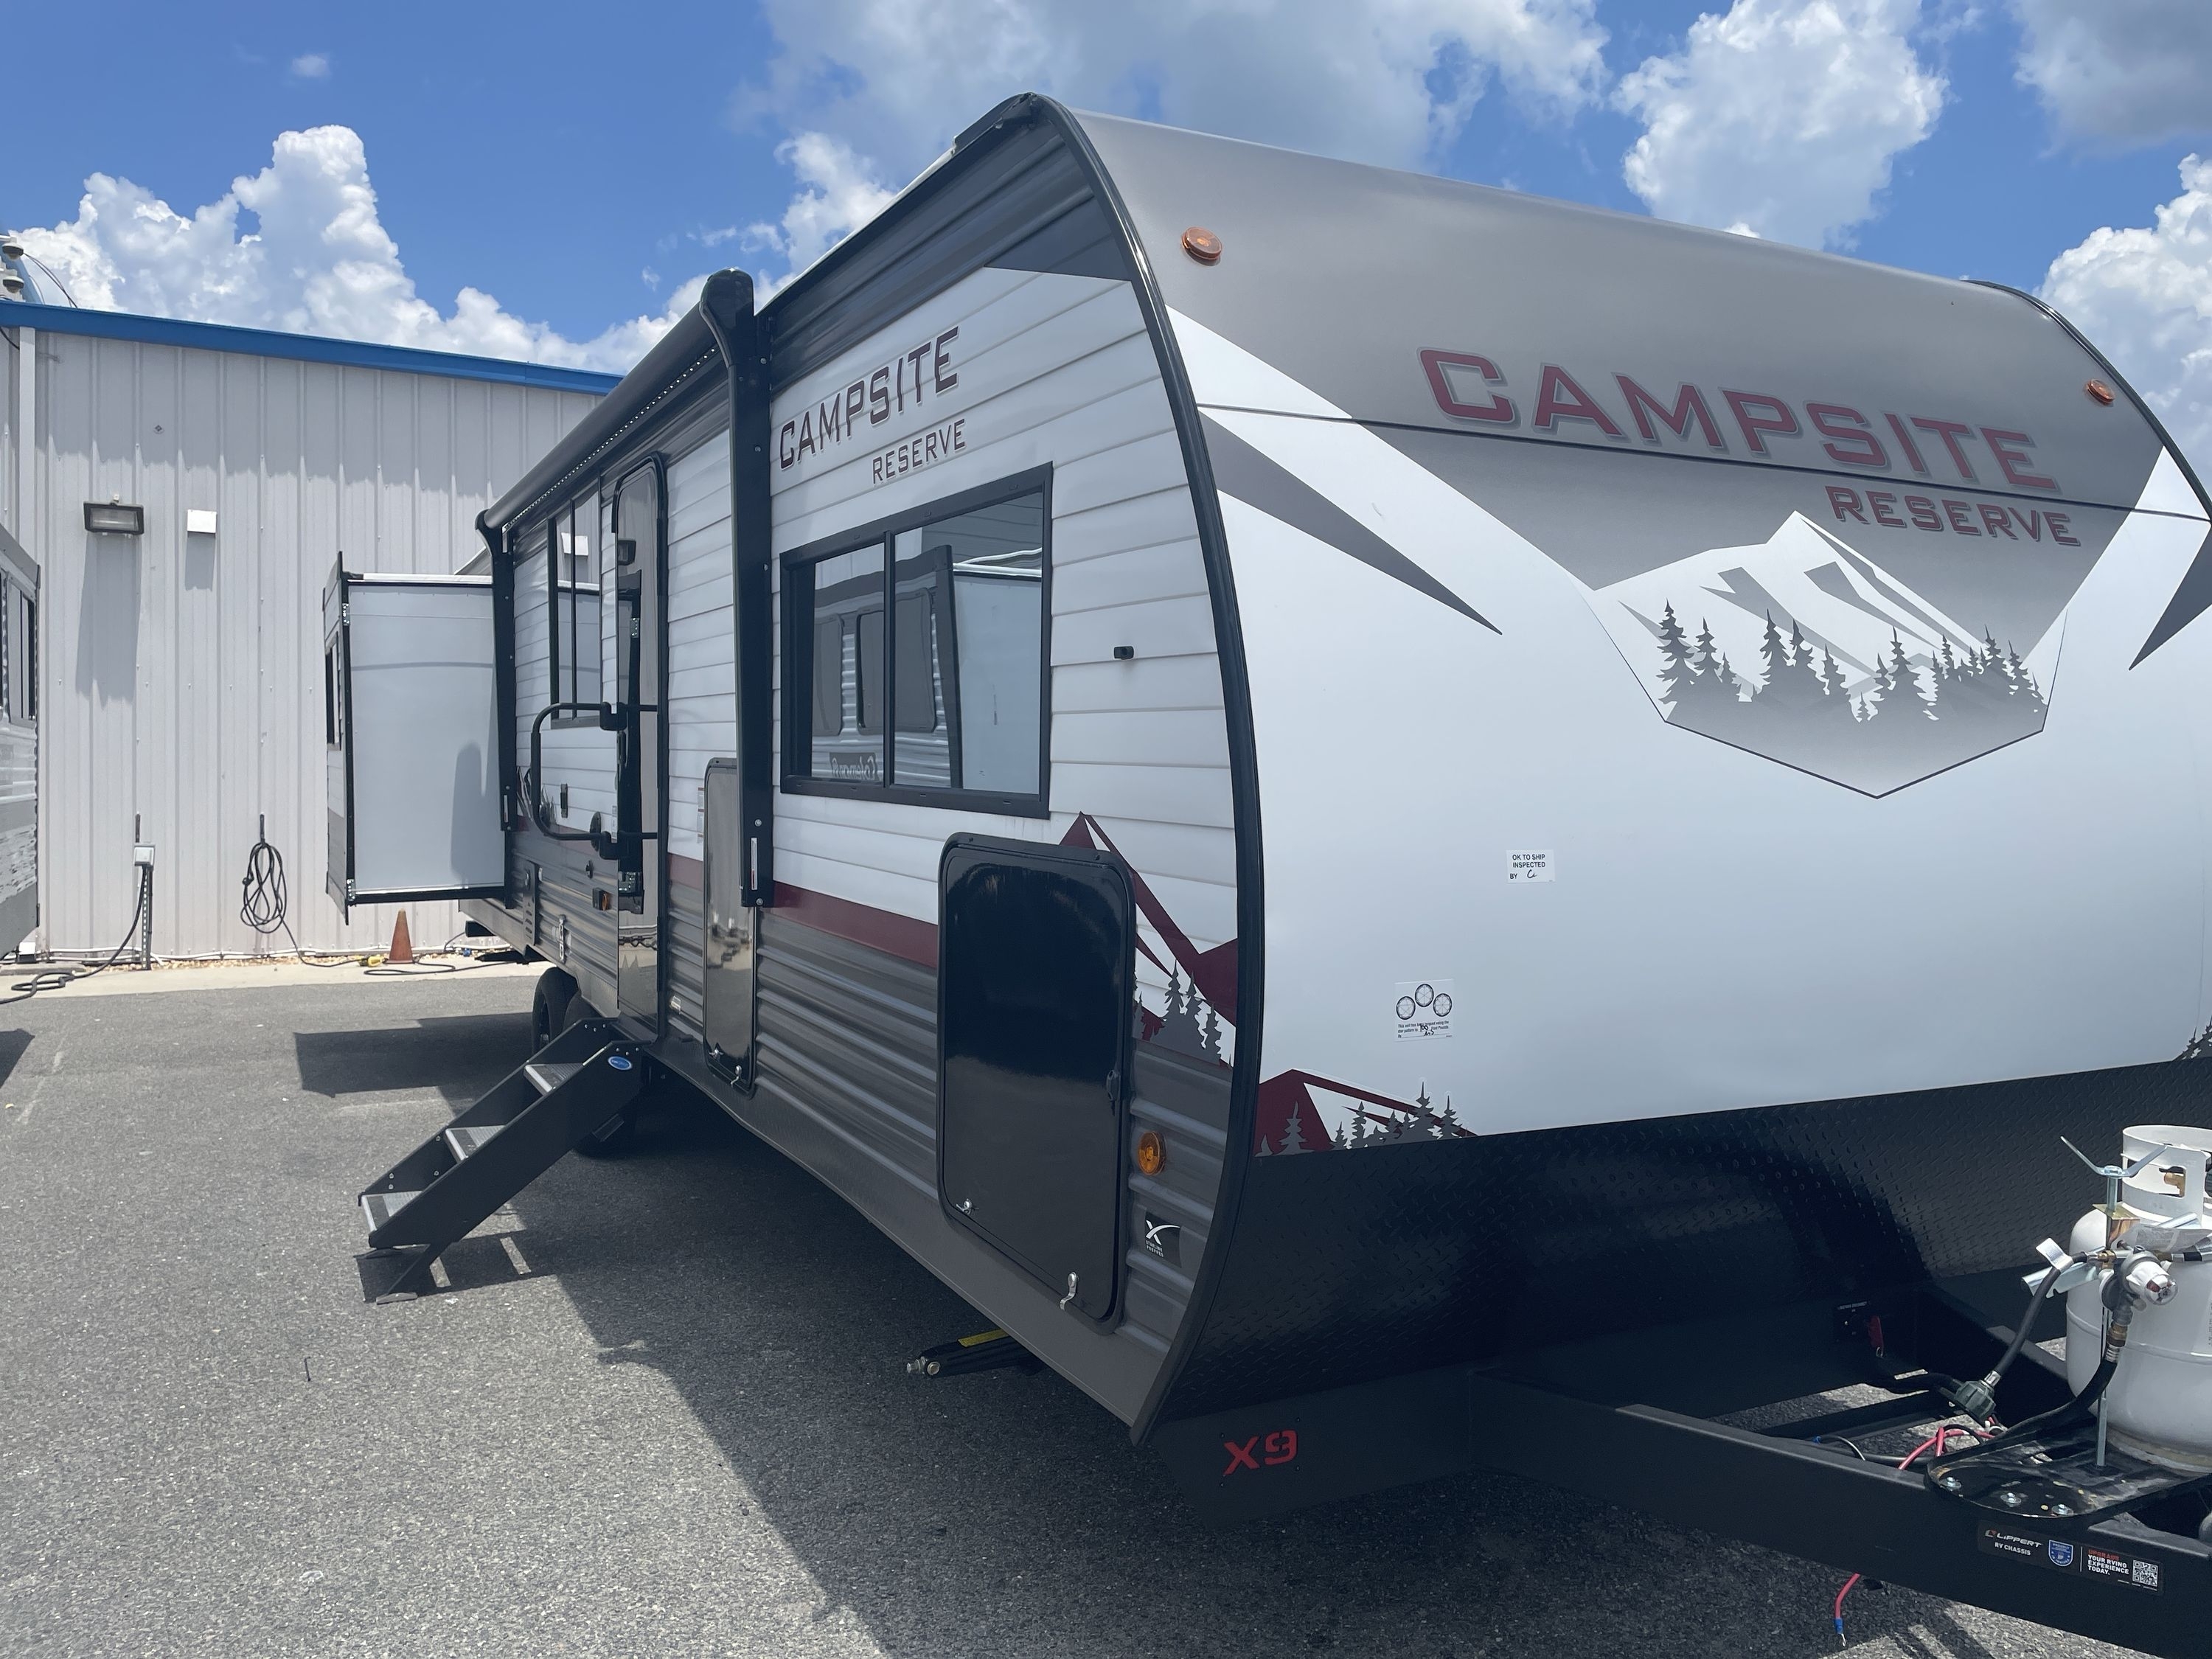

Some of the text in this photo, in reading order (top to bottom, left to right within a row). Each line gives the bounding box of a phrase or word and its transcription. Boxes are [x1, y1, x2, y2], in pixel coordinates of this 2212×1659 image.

[779, 326, 959, 470] CAMPSITE
[1418, 347, 2059, 490] CAMPSITE
[873, 418, 966, 484] RESERVE
[1825, 485, 2081, 546] RESERVE
[1223, 1430, 1298, 1475] X9
[2004, 1544, 2031, 1556] CHASSIS
[2087, 1565, 2110, 1576] TODAY.
[2088, 1554, 2106, 1563] YOUR
[2088, 1560, 2129, 1575] EXPERIENCE
